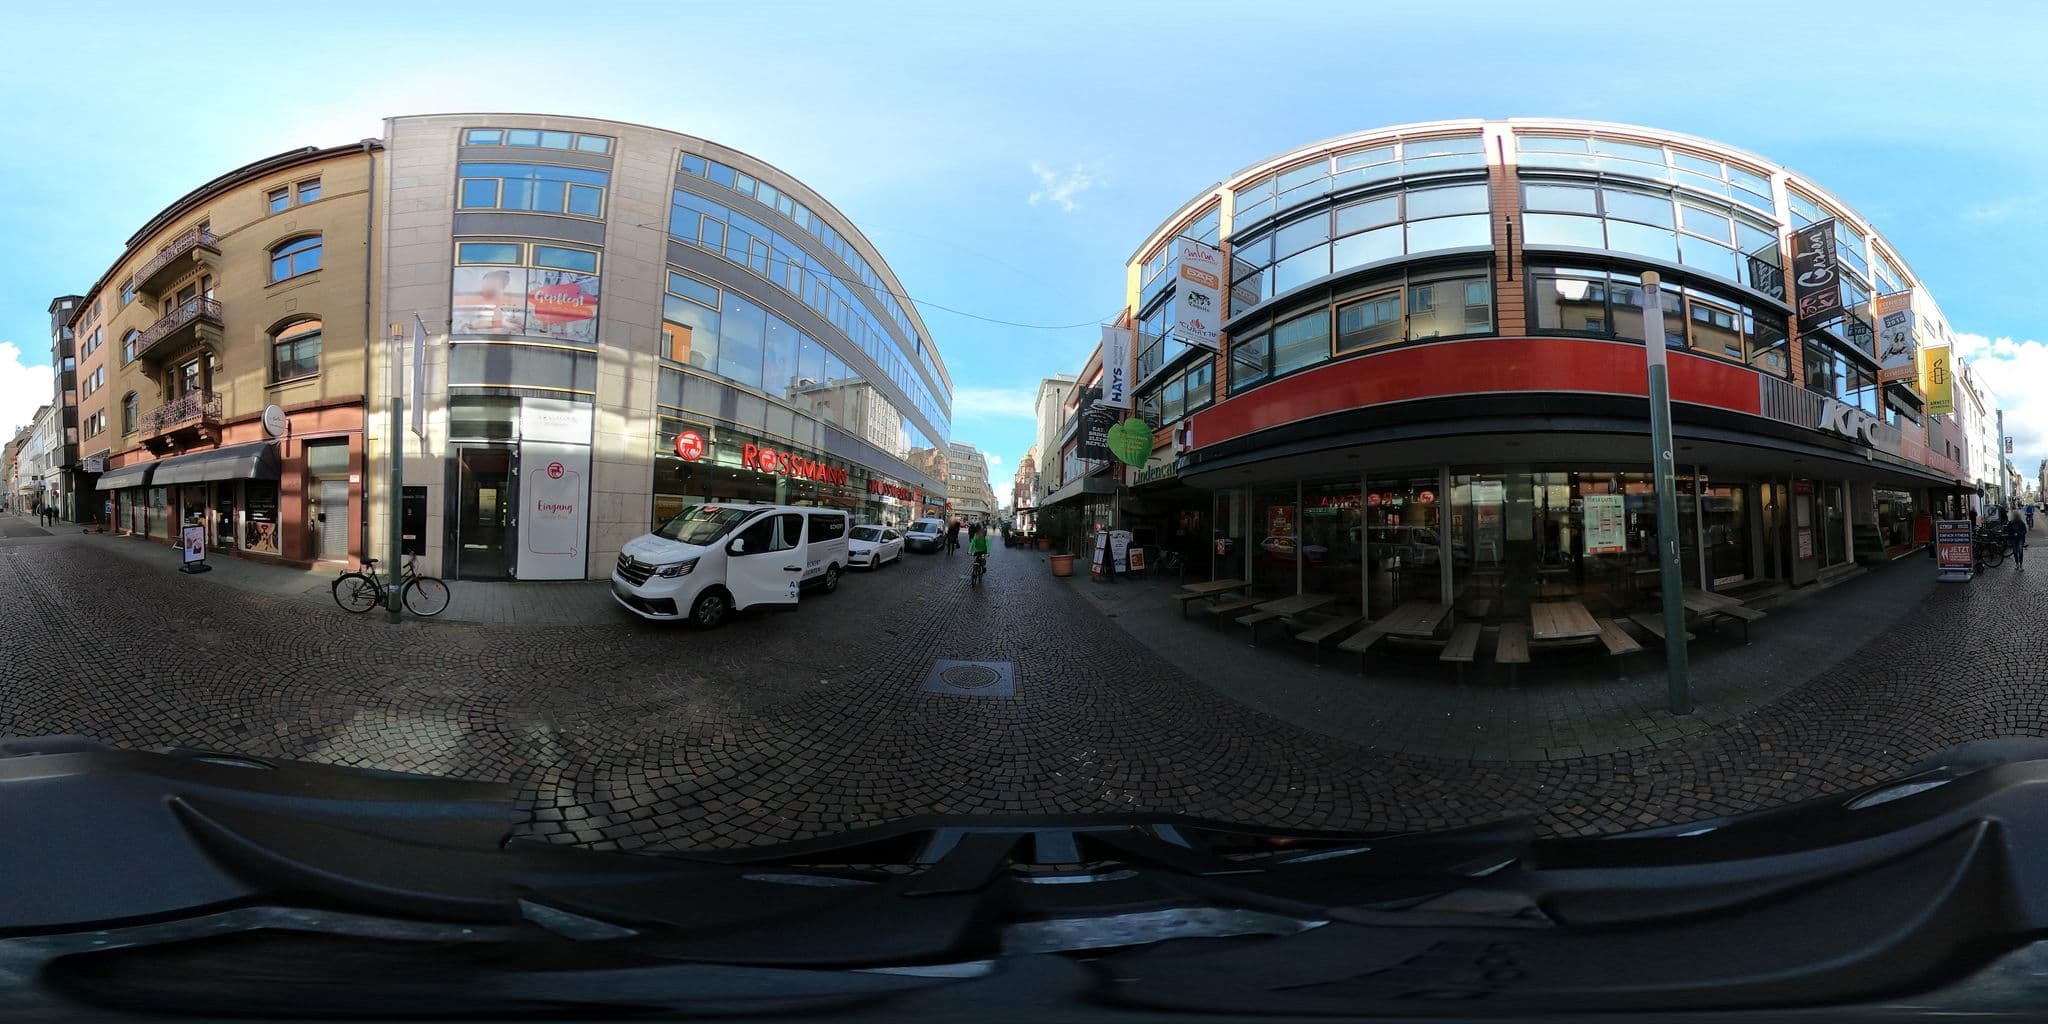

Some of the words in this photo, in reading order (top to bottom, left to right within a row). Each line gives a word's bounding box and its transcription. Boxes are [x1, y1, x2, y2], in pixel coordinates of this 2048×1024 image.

[534, 290, 585, 307] Gepflegt
[1112, 367, 1123, 402] HAYS
[1818, 397, 1880, 448] KFC
[742, 443, 848, 486] ROSSMANN
[537, 499, 573, 514] Eingang
